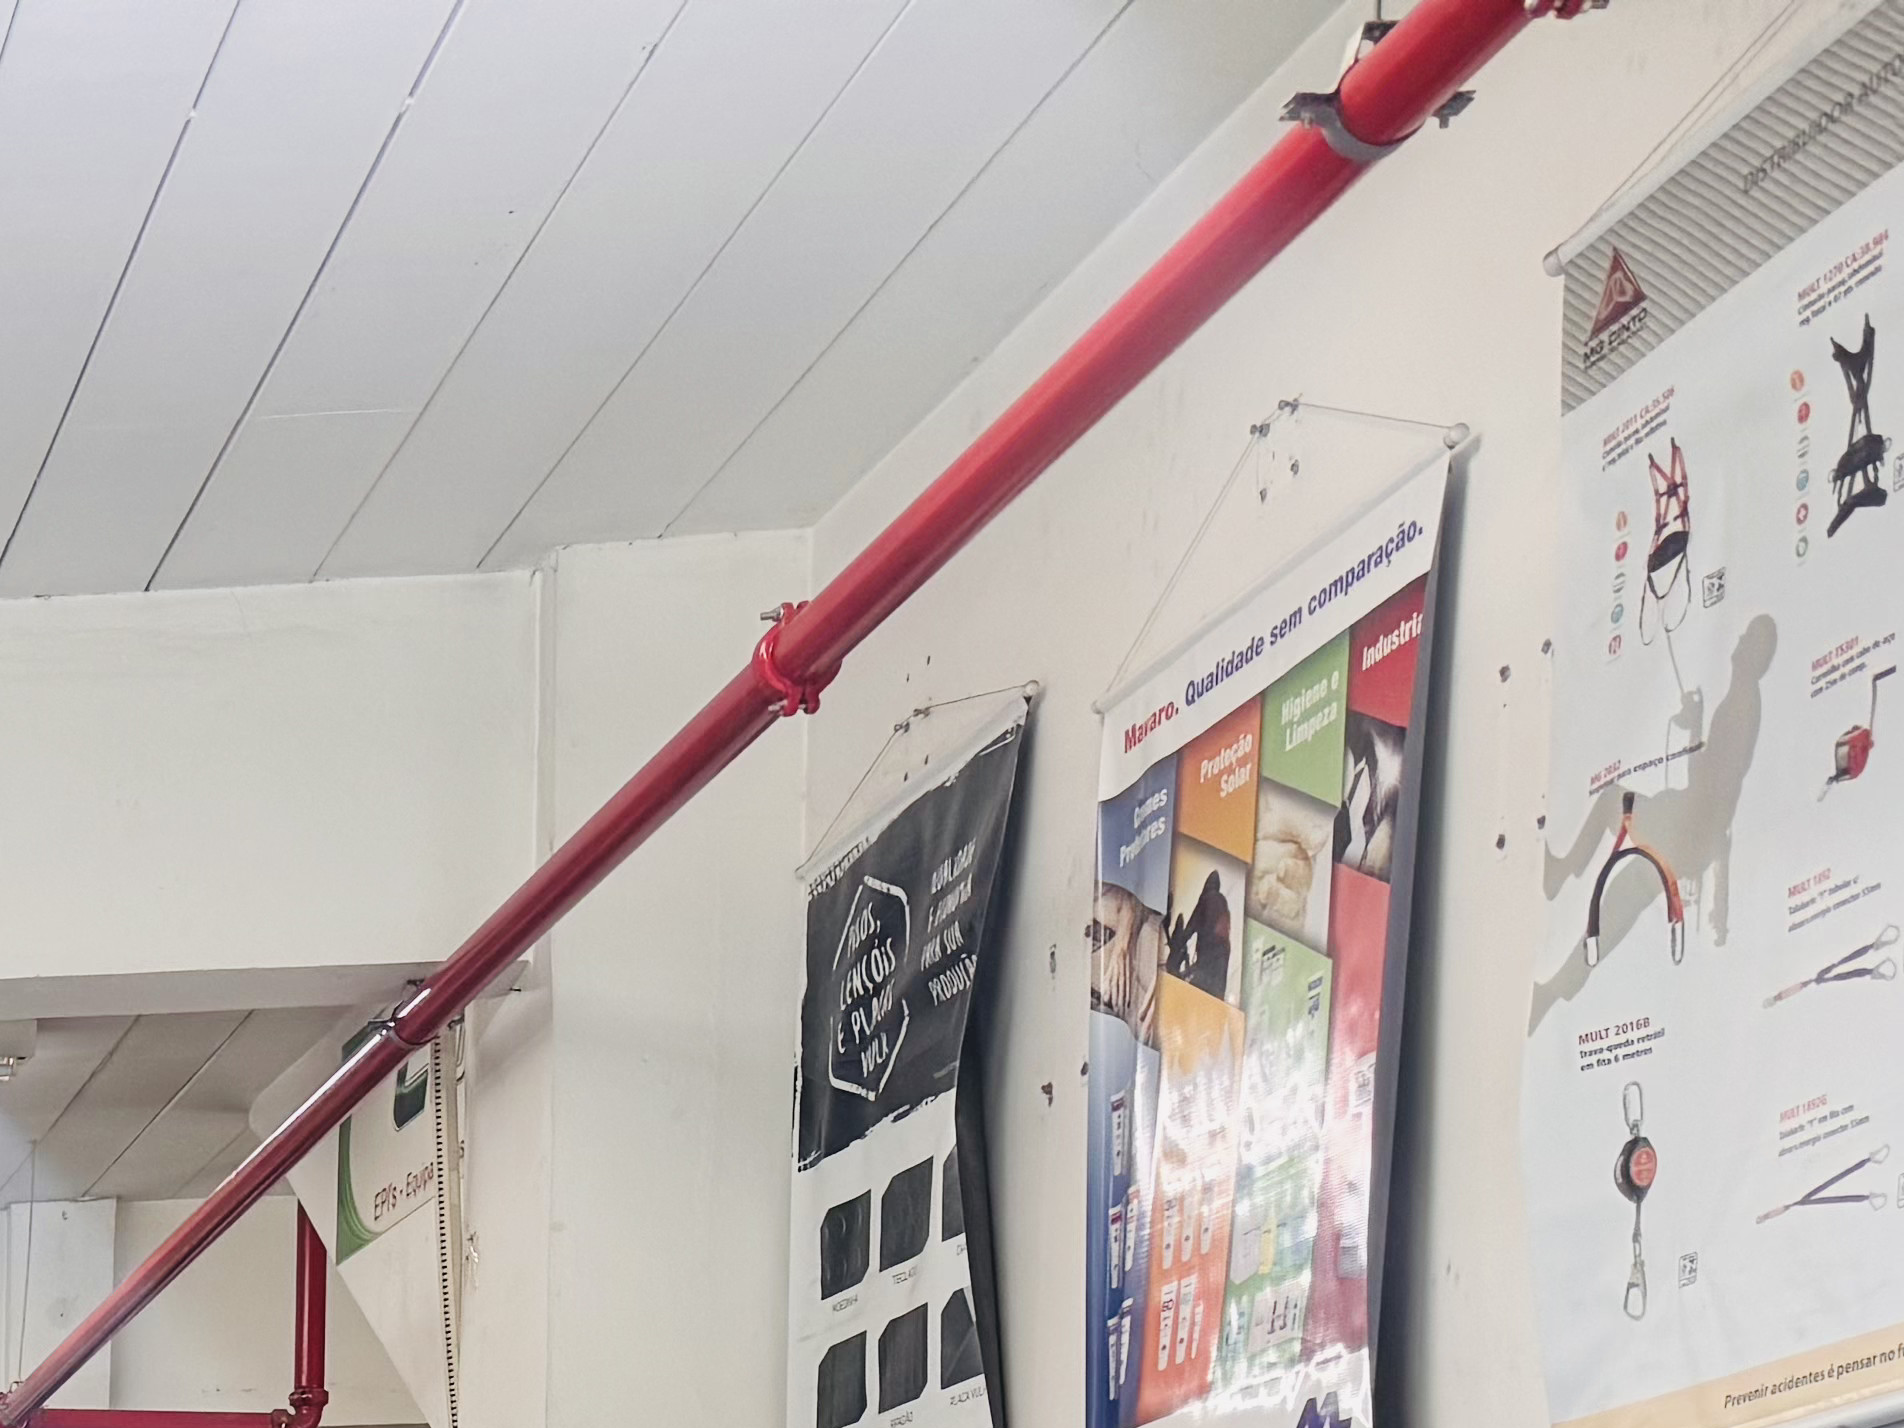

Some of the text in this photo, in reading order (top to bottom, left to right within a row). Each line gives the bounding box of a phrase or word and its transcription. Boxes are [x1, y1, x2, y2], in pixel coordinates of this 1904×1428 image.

[1185, 636, 1265, 707] Qualidade
[1270, 606, 1303, 648] sem
[1307, 519, 1424, 619] comparação.
[1330, 669, 1340, 690] e
[1200, 732, 1253, 783] Proteção
[1220, 766, 1252, 797] Solar
[1579, 1027, 1611, 1046] MULT
[1723, 1385, 1770, 1410] Prevenir
[1770, 1371, 1826, 1396] acidentes
[1837, 1353, 1878, 1384] pensar
[1880, 1349, 1897, 1364] no
